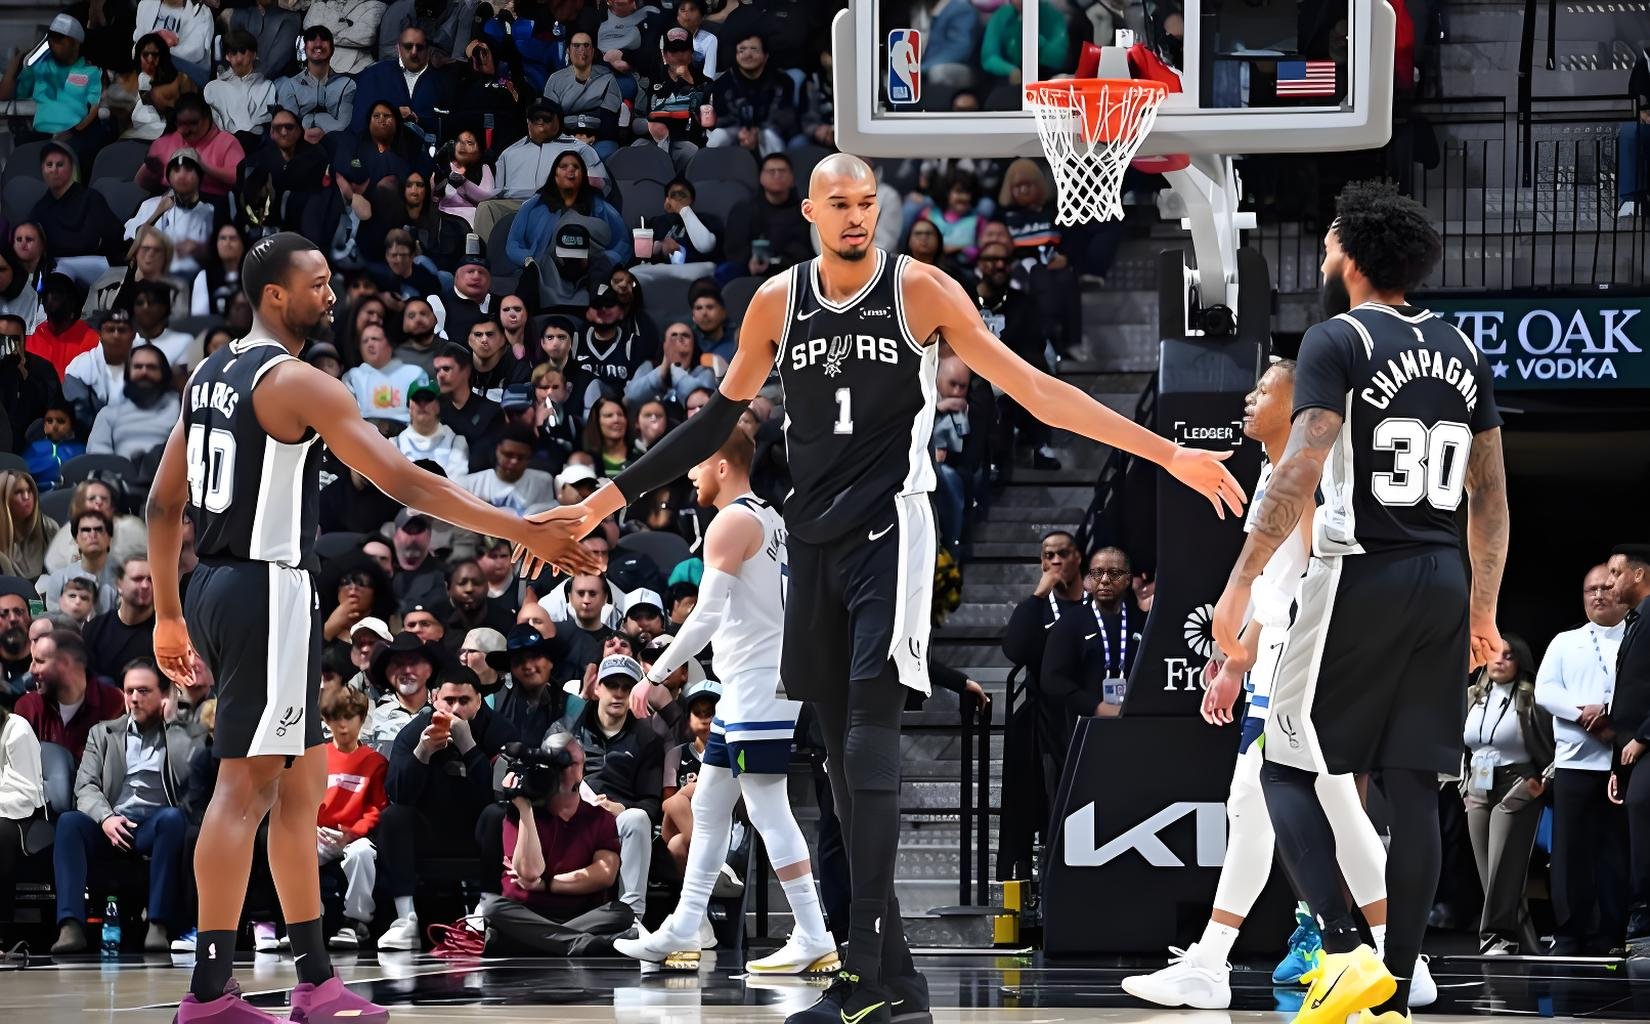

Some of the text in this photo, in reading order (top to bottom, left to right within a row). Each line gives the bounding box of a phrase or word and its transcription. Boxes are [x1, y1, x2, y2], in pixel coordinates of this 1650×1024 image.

[1517, 308, 1643, 355] OAK
[791, 334, 899, 377] SPURS
[1516, 358, 1618, 380] VODKA
[833, 387, 854, 434] 1
[187, 423, 237, 514] 40
[1371, 417, 1473, 511] 30
